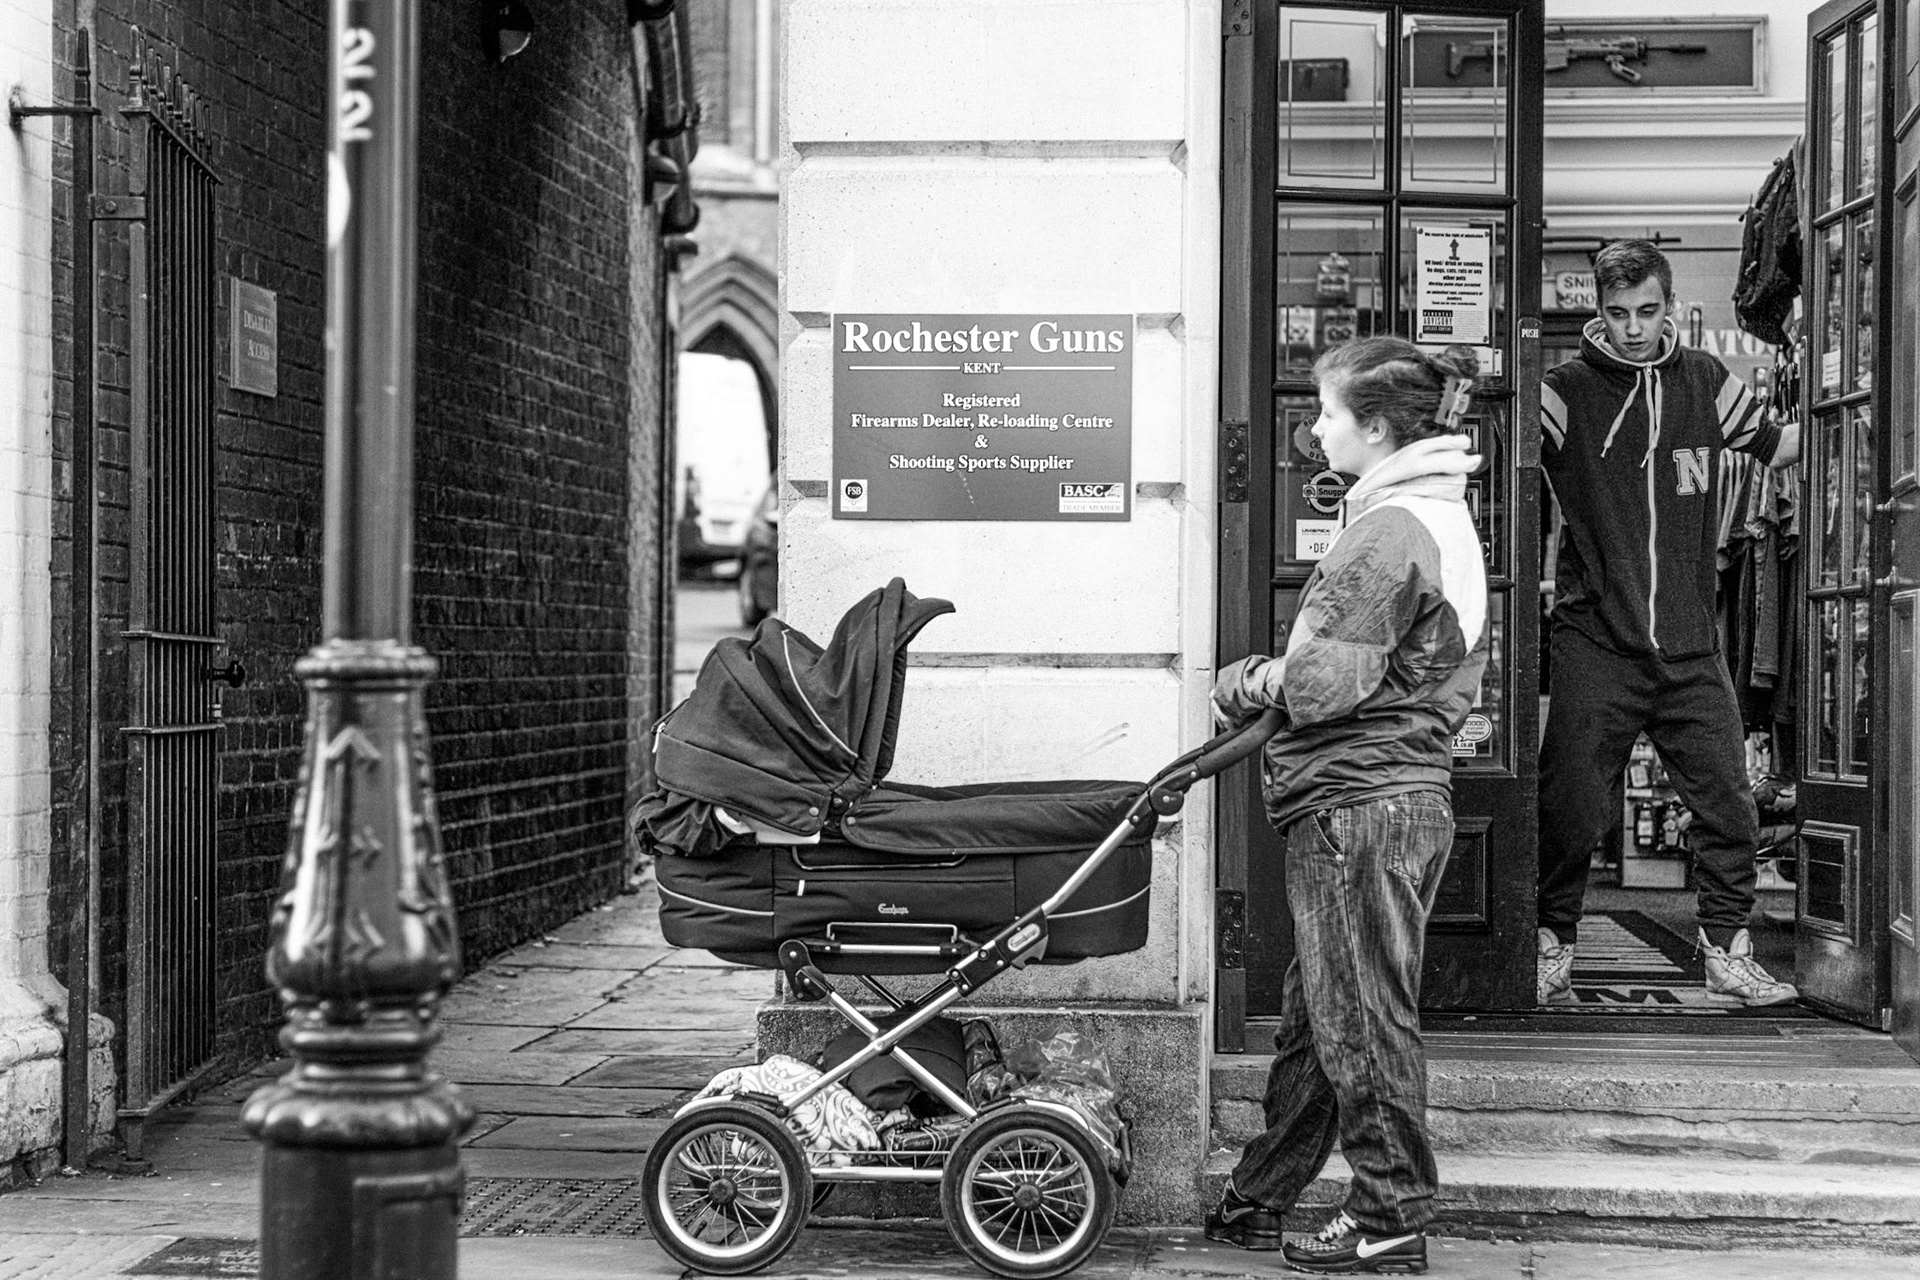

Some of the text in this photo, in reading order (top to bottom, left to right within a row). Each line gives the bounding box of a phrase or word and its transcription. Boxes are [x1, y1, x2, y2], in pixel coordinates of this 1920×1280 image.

[842, 321, 1124, 353] Rochester Guns
[1521, 328, 1539, 338] PUSH
[248, 339, 270, 360] ACCESS
[963, 363, 1001, 373] KENT
[943, 393, 1021, 410] Registered
[851, 414, 1113, 430] Firearms Dealer, Re-loading Centre
[975, 435, 989, 448] &
[889, 455, 1074, 472] Shooting Sports Supplier
[1673, 447, 1710, 495] N
[847, 486, 862, 496] FSB
[1064, 485, 1104, 497] BASC
